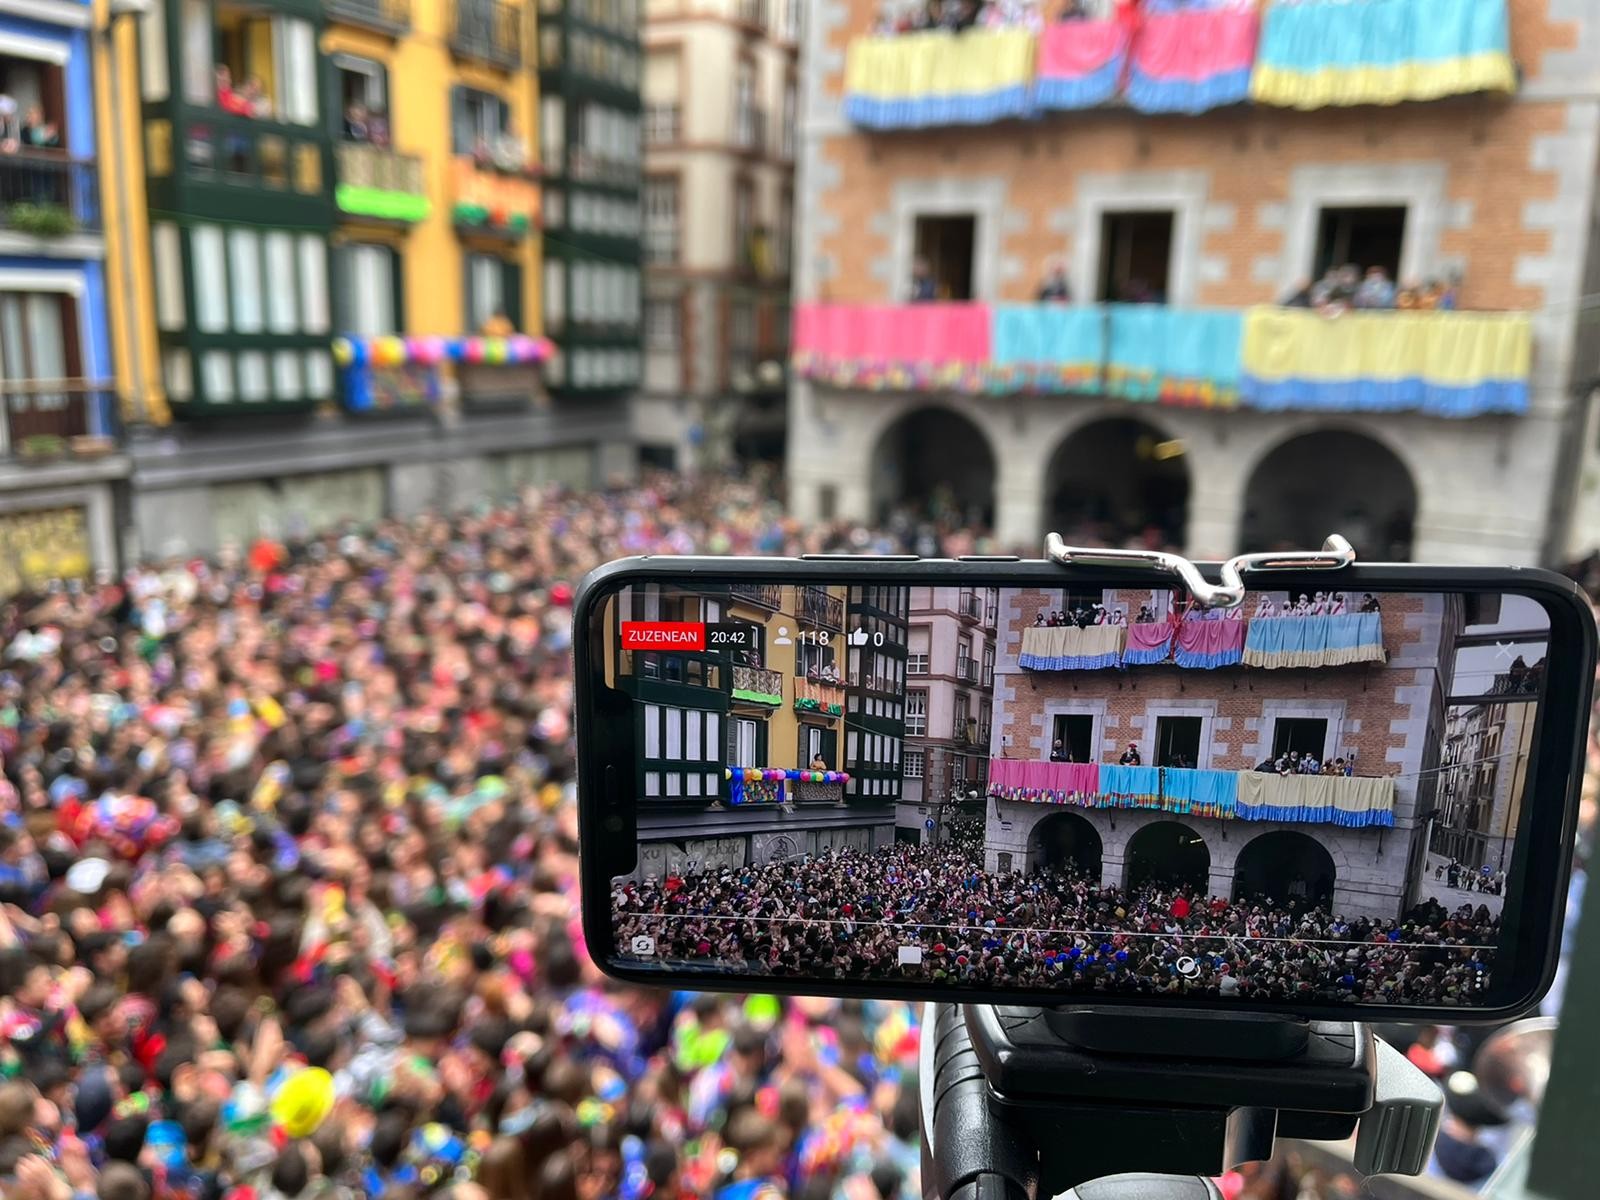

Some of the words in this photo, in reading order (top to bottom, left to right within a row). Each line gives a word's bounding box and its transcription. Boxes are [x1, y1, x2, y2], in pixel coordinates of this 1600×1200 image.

[628, 630, 698, 643] ZUZENEAN
[711, 631, 746, 644] 20:42
[799, 630, 829, 646] 118
[873, 631, 884, 647] 0
